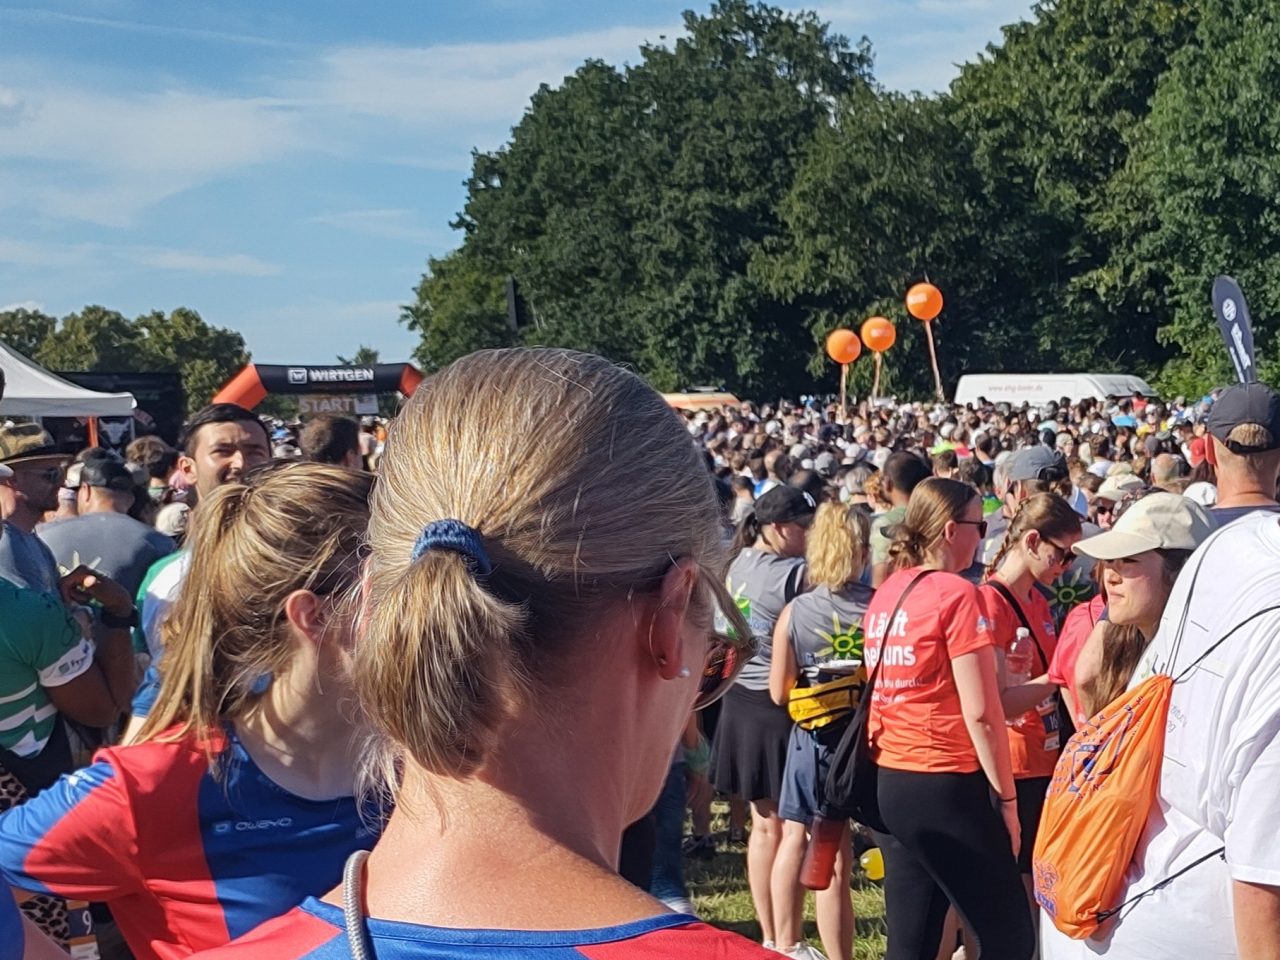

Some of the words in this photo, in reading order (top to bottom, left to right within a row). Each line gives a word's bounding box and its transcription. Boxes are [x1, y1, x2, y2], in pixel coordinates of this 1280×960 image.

[309, 368, 374, 381] WIRTGEN
[301, 398, 351, 413] START
[883, 644, 916, 667] uns
